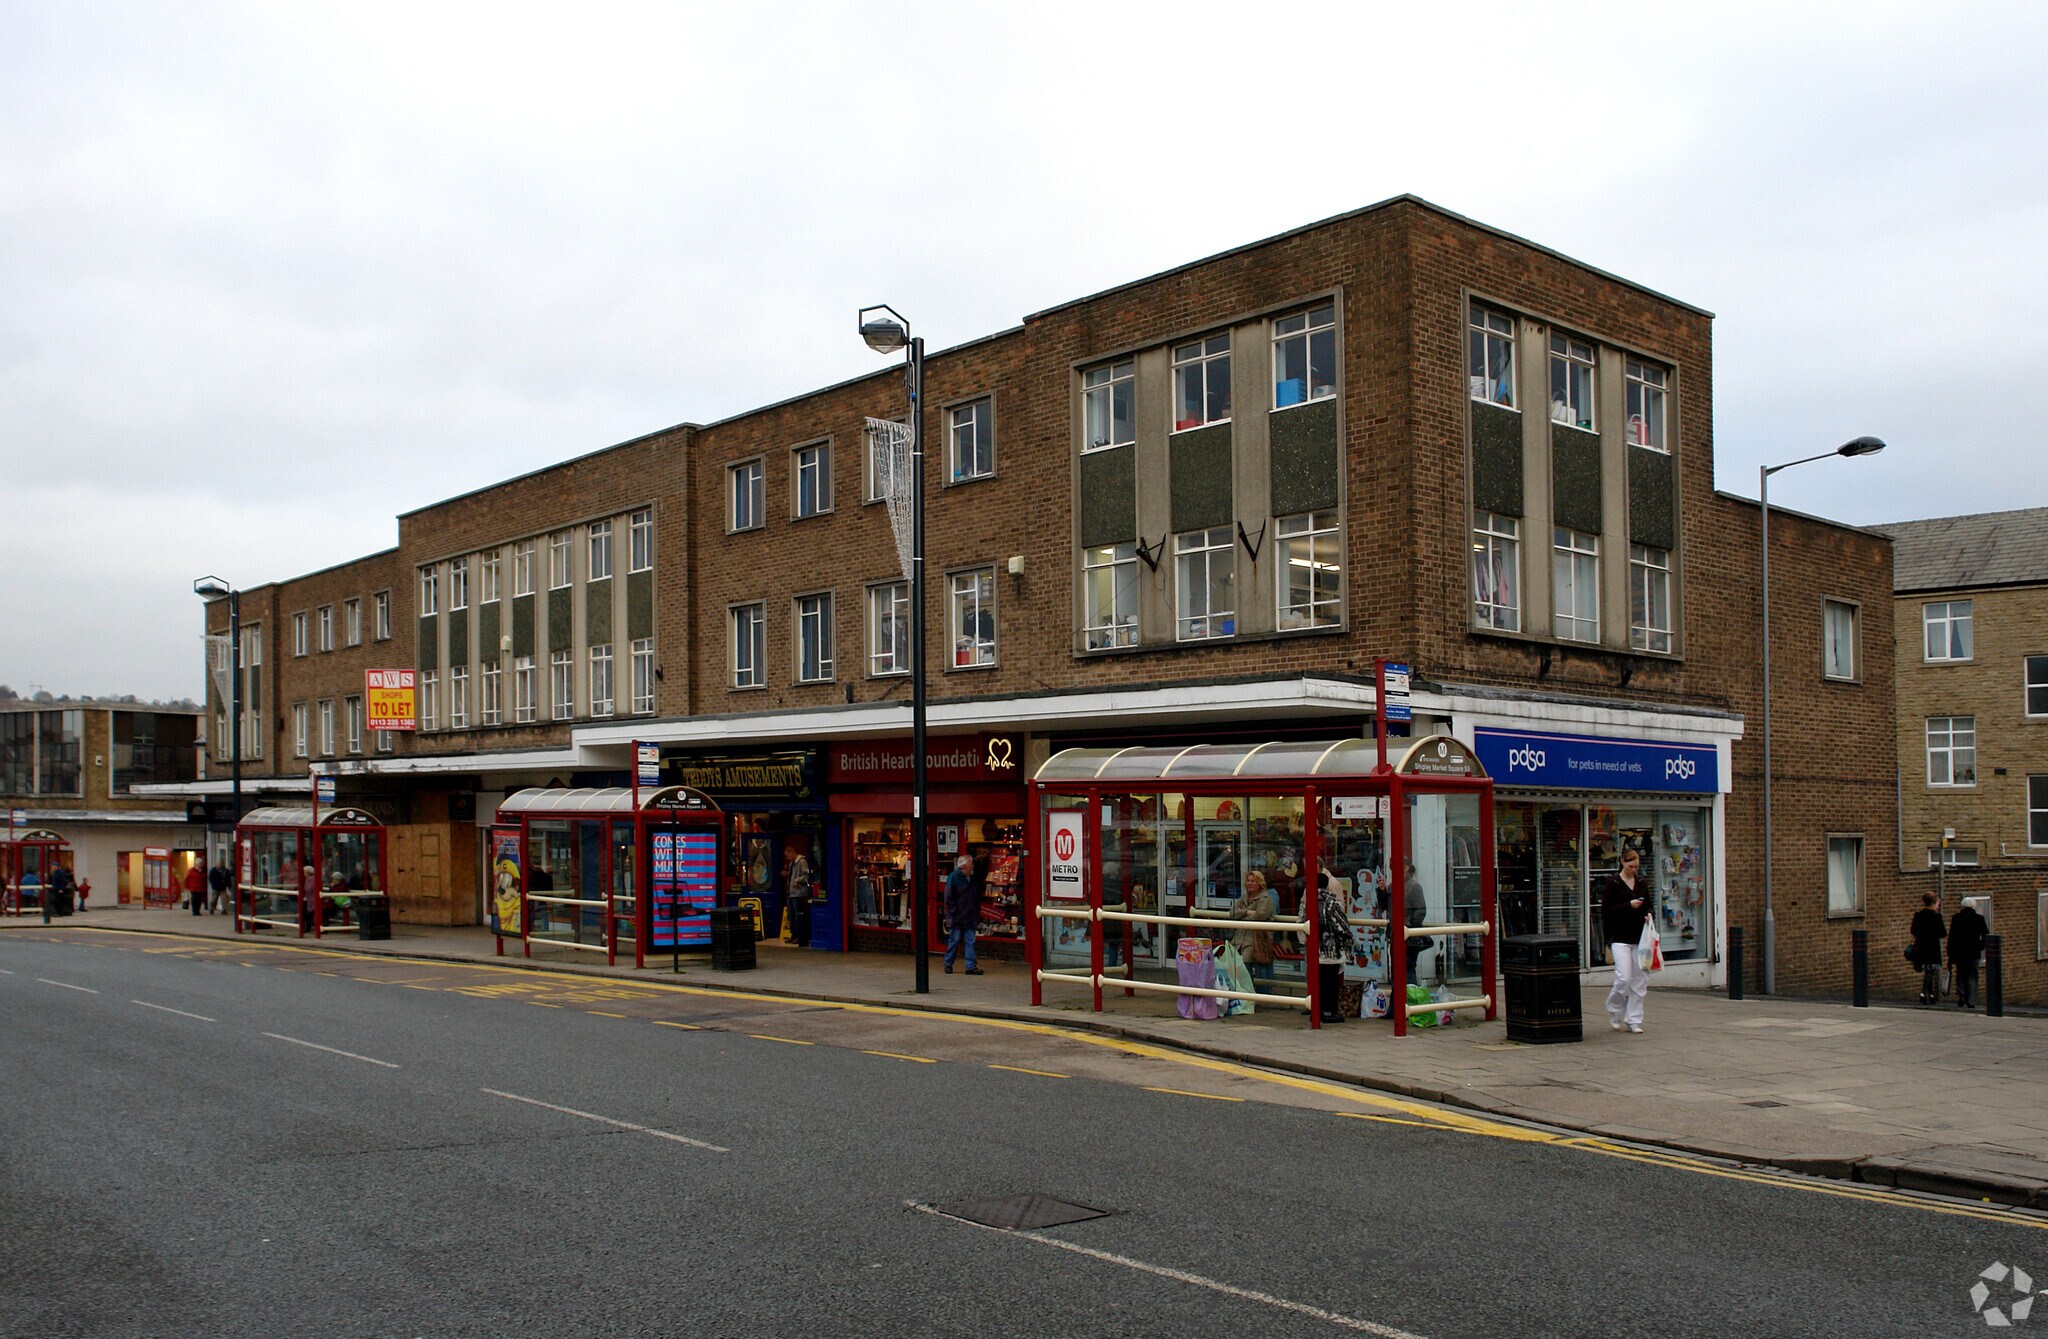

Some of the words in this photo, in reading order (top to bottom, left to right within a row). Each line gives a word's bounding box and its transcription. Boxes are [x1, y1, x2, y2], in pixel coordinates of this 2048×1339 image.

[380, 691, 403, 699] SHOPS
[373, 702, 388, 716] TO
[391, 702, 411, 716] LET
[840, 752, 878, 771] British
[881, 752, 915, 769] Heart
[926, 748, 979, 769] oundati
[1509, 743, 1546, 772] pdsa
[1568, 757, 1578, 769] for
[1579, 760, 1595, 772] pets
[1595, 759, 1602, 770] in
[1602, 761, 1619, 771] need
[1619, 761, 1627, 771] of
[1628, 762, 1642, 772] vets
[1414, 762, 1431, 771] Shipley
[1665, 753, 1696, 780] pdsa
[725, 764, 802, 788] AMUSEMENTS
[1057, 835, 1072, 854] M
[1052, 864, 1078, 874] METRO
